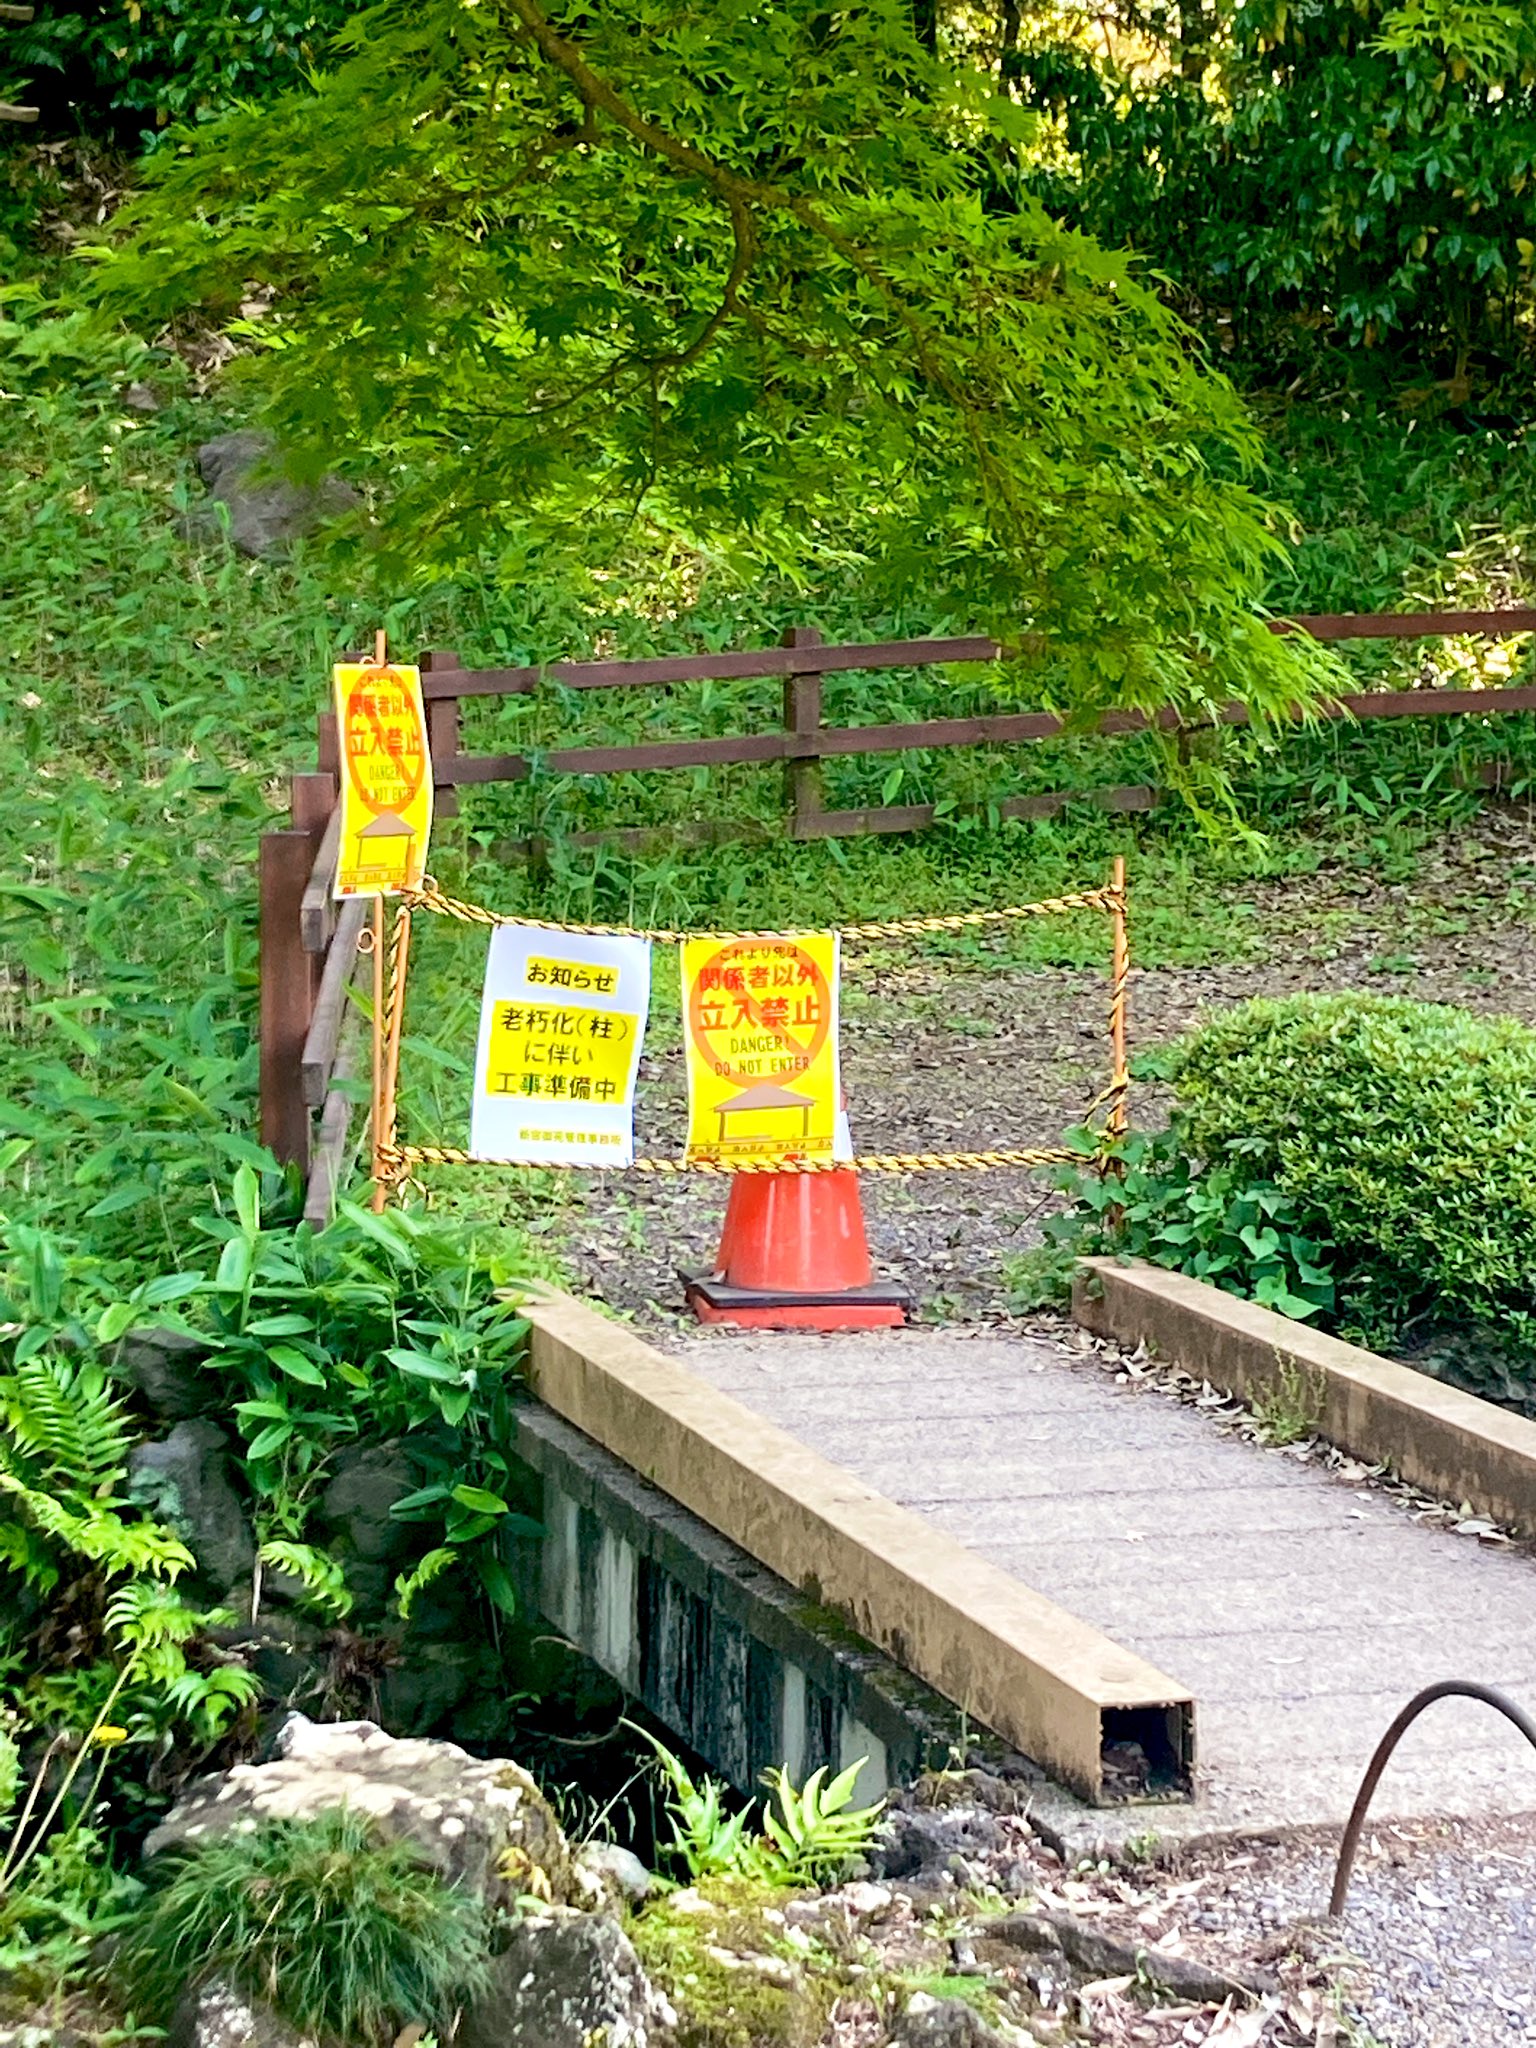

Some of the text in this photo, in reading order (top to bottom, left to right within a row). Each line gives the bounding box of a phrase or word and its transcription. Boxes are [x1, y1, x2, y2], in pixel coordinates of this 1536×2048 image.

[349, 727, 420, 756] 立入禁止
[720, 946, 798, 961] これより先は
[527, 963, 613, 992] お知らせ
[699, 963, 819, 993] 関係者以外
[698, 995, 822, 1031] 立入禁止
[524, 1041, 594, 1065] に伴い
[714, 1056, 809, 1077] DO NOT ENTER
[494, 1072, 617, 1100] 工事準備中
